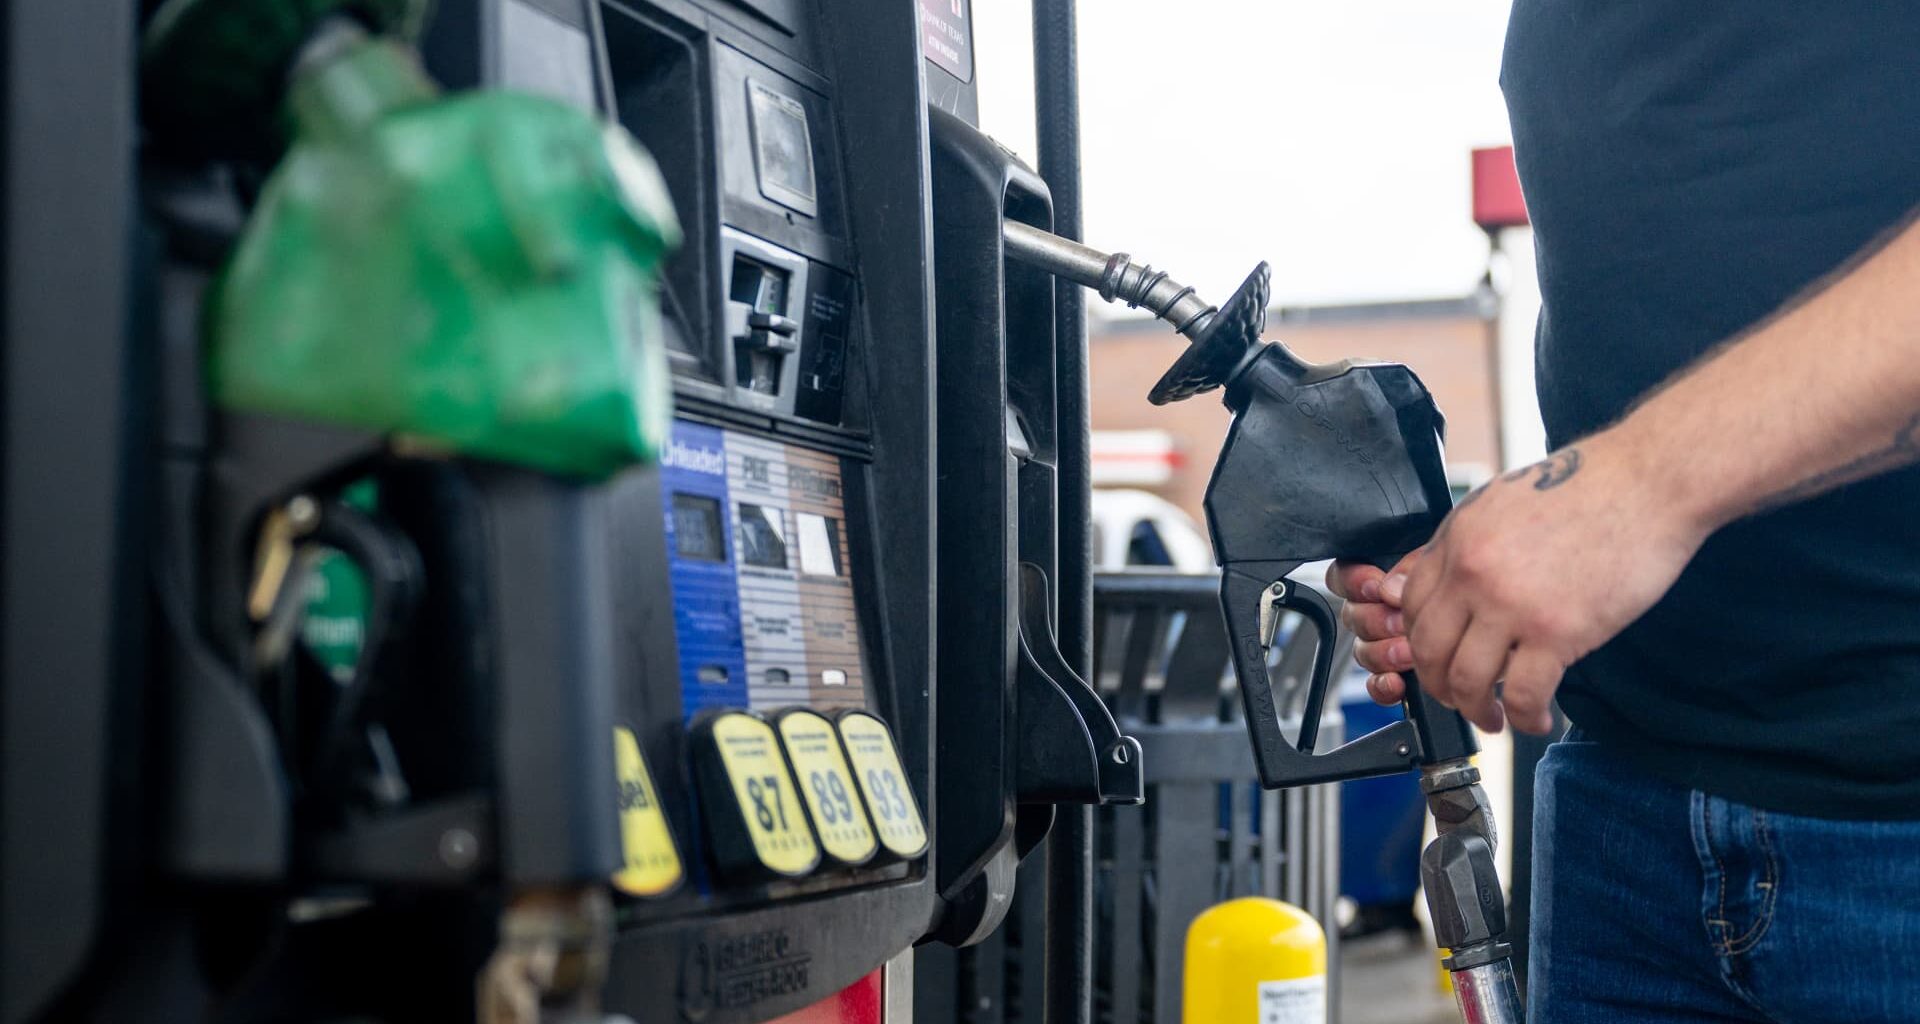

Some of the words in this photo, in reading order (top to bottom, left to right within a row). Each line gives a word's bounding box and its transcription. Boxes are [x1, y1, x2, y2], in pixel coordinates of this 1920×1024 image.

[746, 775, 787, 832] 87
[811, 770, 853, 824] 89
[868, 769, 908, 820] 93
